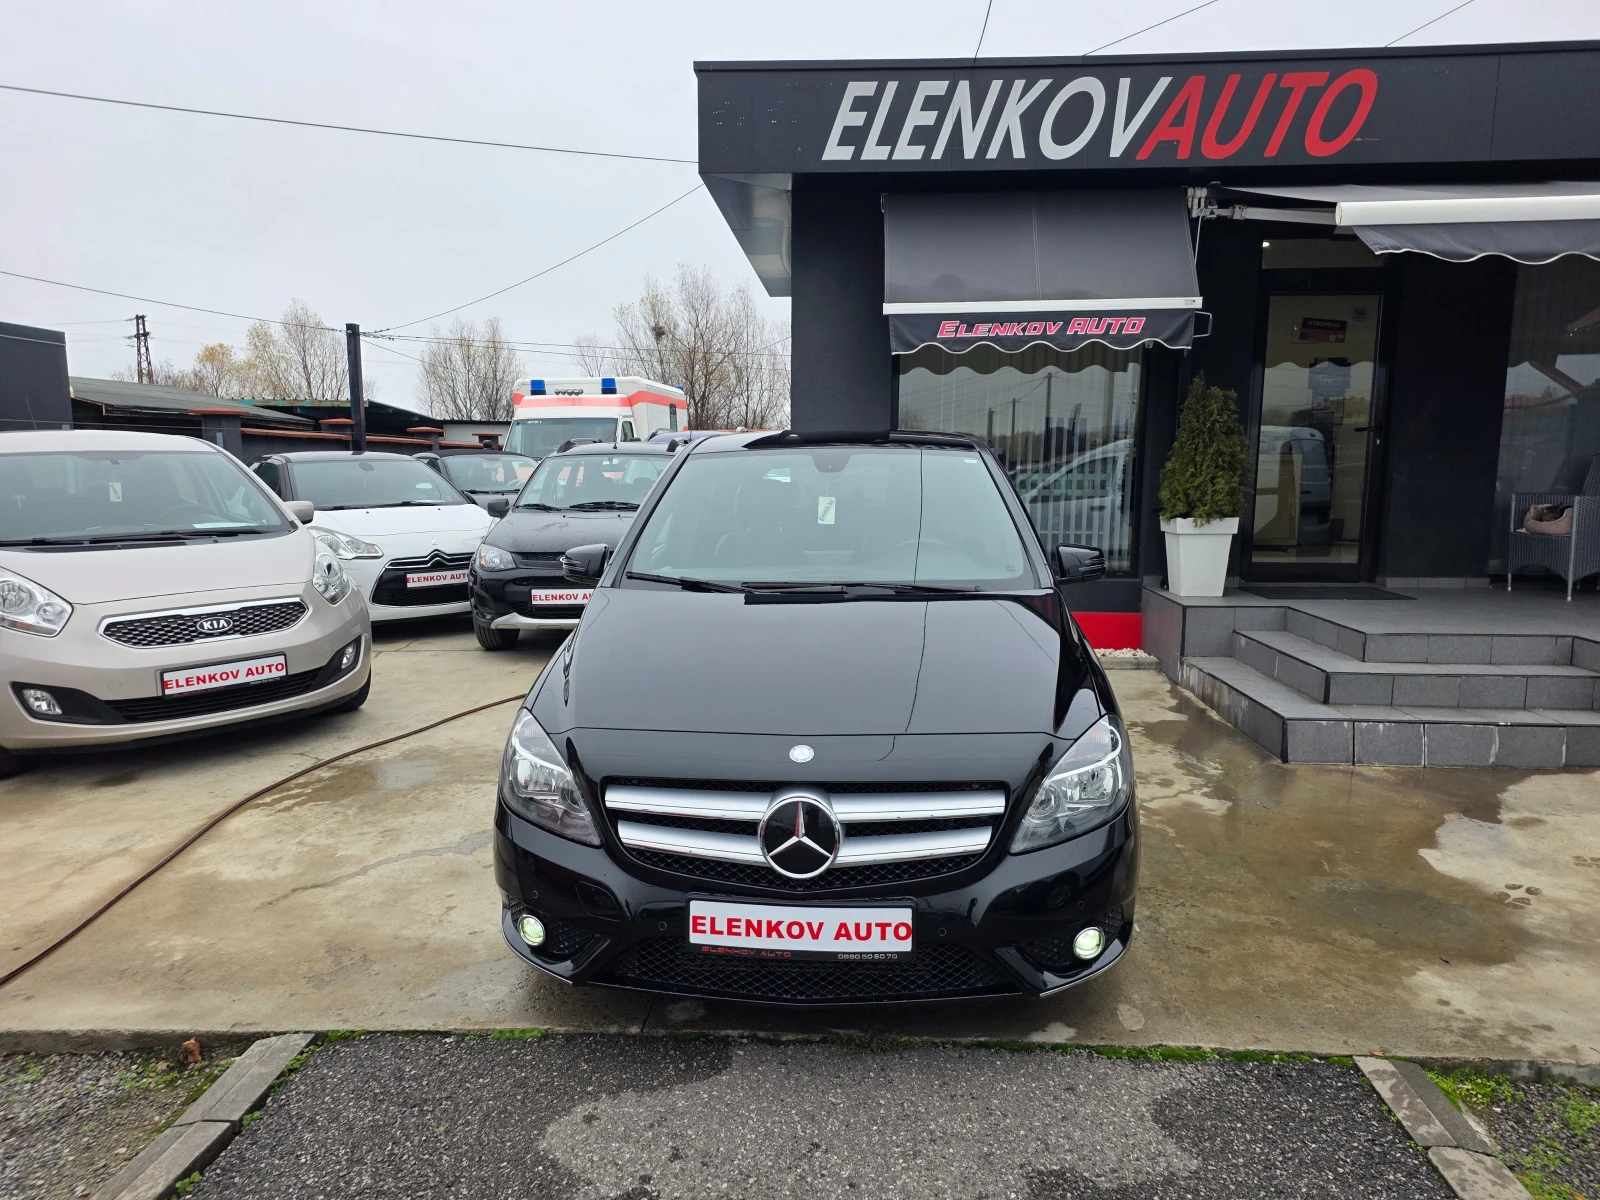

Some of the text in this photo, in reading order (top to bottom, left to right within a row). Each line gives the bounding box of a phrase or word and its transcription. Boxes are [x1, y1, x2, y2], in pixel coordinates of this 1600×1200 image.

[937, 317, 1146, 338] ELENKOV AUTO
[405, 574, 448, 584] ELENKOV
[532, 593, 579, 602] ELENKOV
[202, 619, 228, 630] KIA
[163, 669, 240, 690] ELENKOV
[245, 662, 285, 678] AUTO
[691, 915, 913, 942] ELENKOV AUTO
[701, 946, 792, 958] ELENKOV AUTO
